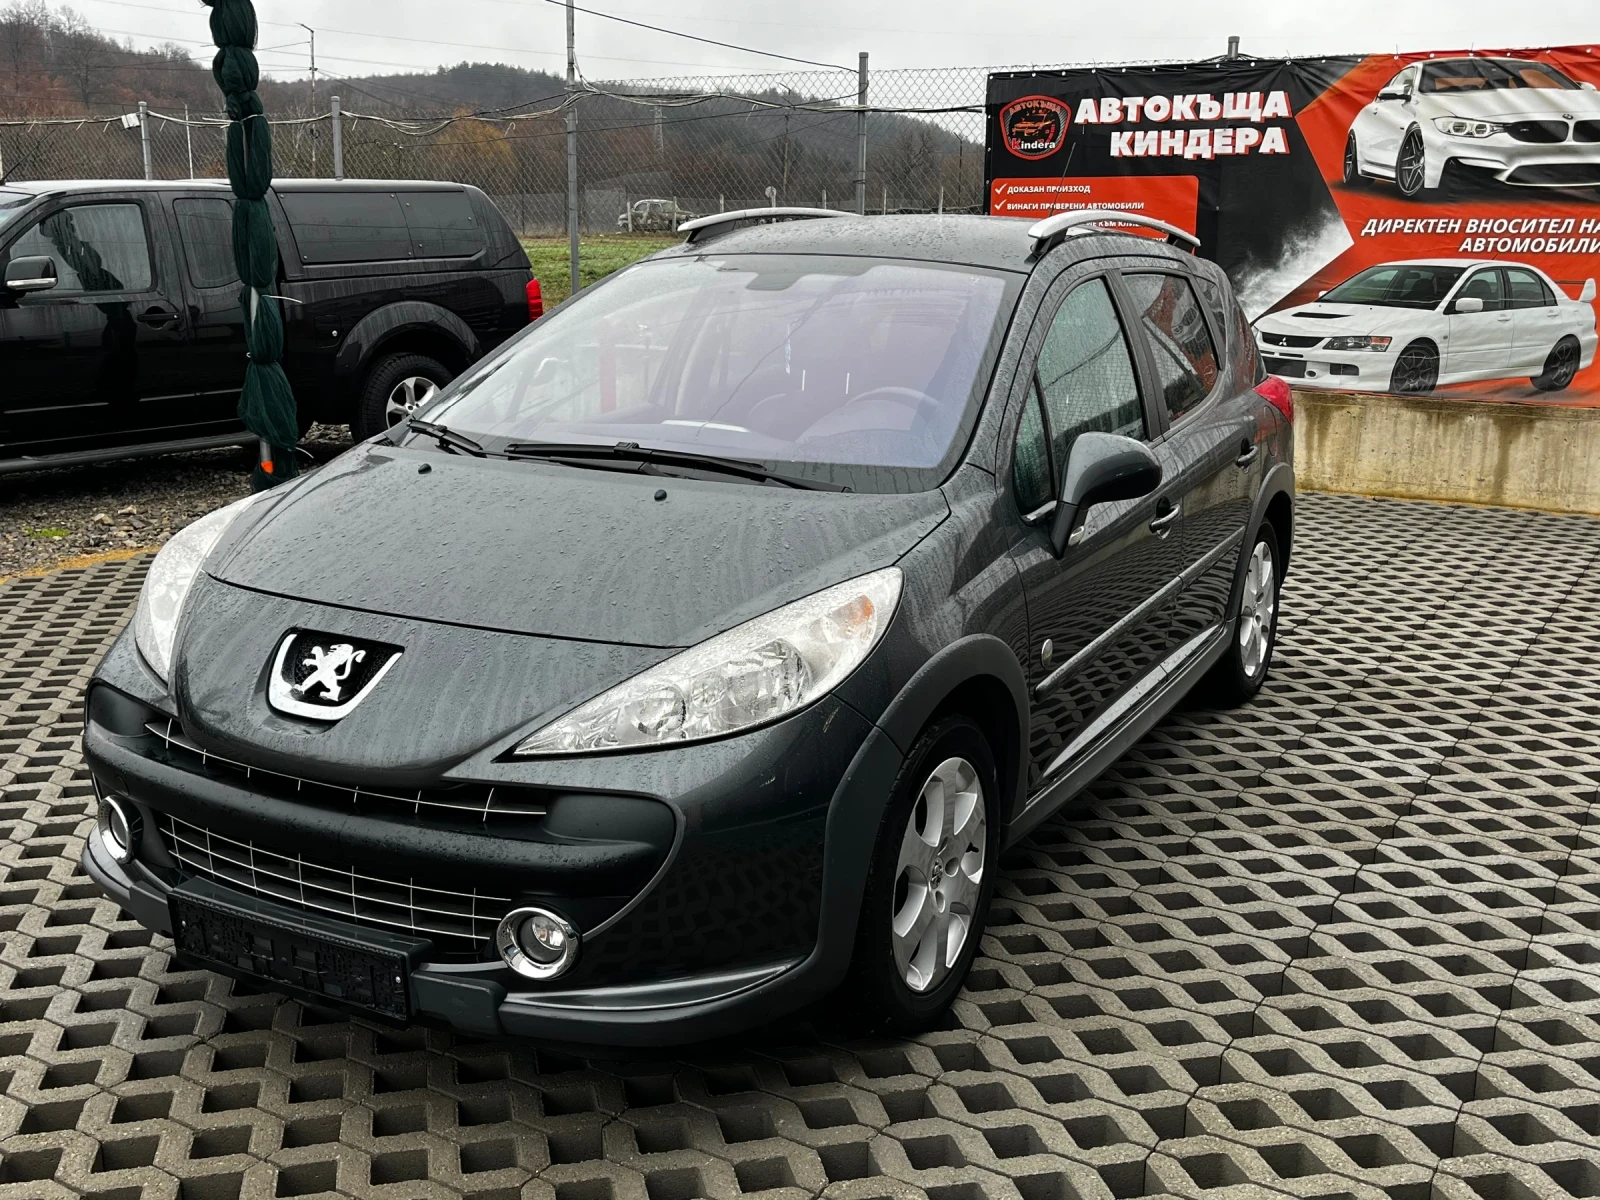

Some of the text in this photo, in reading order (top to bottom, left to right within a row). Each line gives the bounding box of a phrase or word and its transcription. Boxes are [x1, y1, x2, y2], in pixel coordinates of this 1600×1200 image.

[1074, 91, 1291, 124] АВТОКЪЩА
[1011, 138, 1056, 150] Kindera
[1110, 127, 1289, 160] КИНДЕРА
[1006, 185, 1090, 194] ДОКАЗАН ПРОИЗХОД
[1087, 202, 1145, 210] АВТОМОБИЛИ
[1361, 219, 1462, 236] ДИРЕКТЕН
[1465, 218, 1575, 234] ВНОСИТЕЛ
